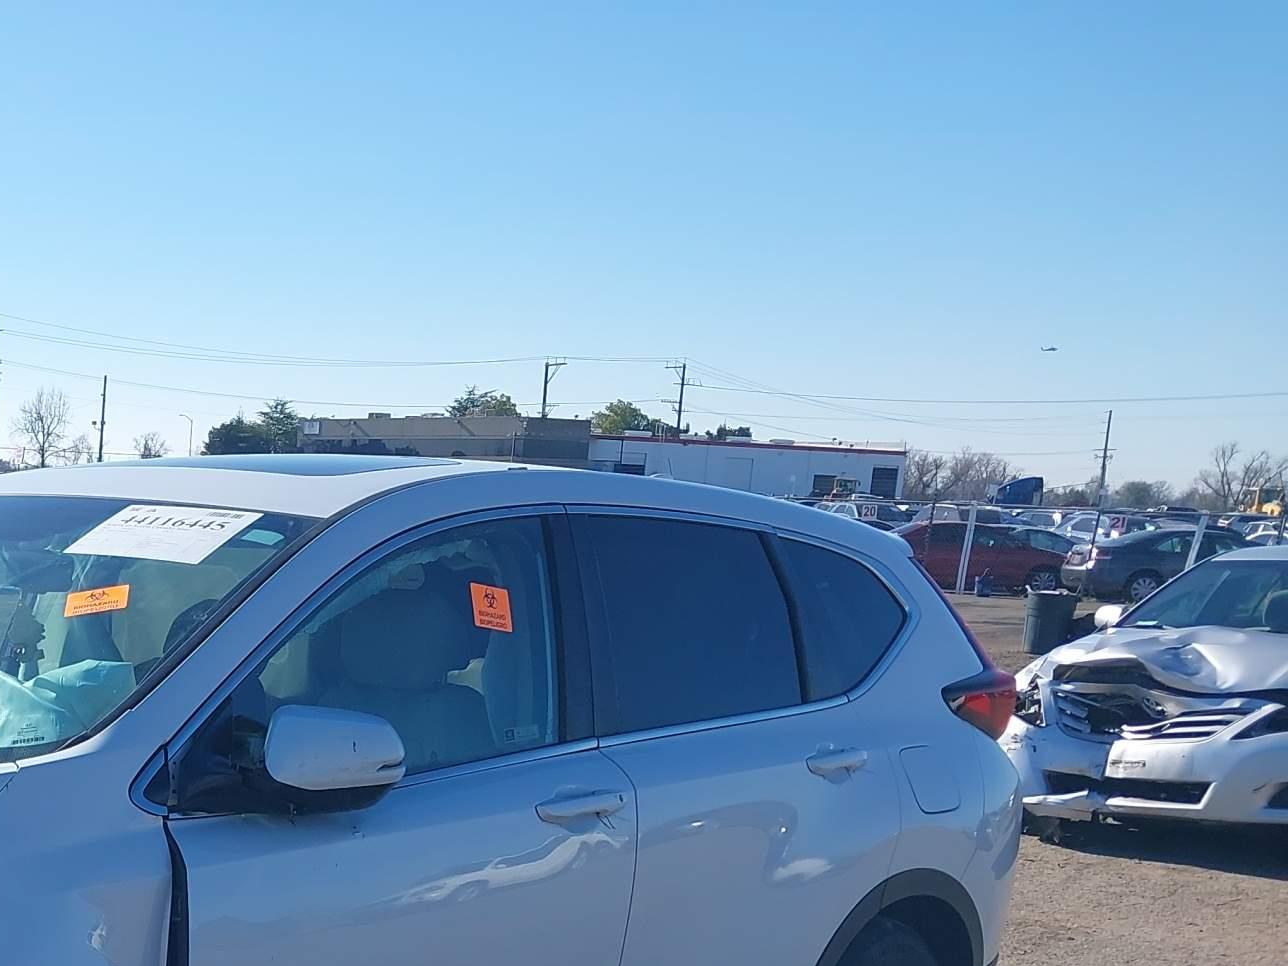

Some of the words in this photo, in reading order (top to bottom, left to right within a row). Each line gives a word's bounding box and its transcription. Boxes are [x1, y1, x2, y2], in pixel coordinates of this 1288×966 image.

[863, 505, 876, 517] 20
[120, 515, 231, 531] 44116445
[1110, 516, 1126, 529] 21
